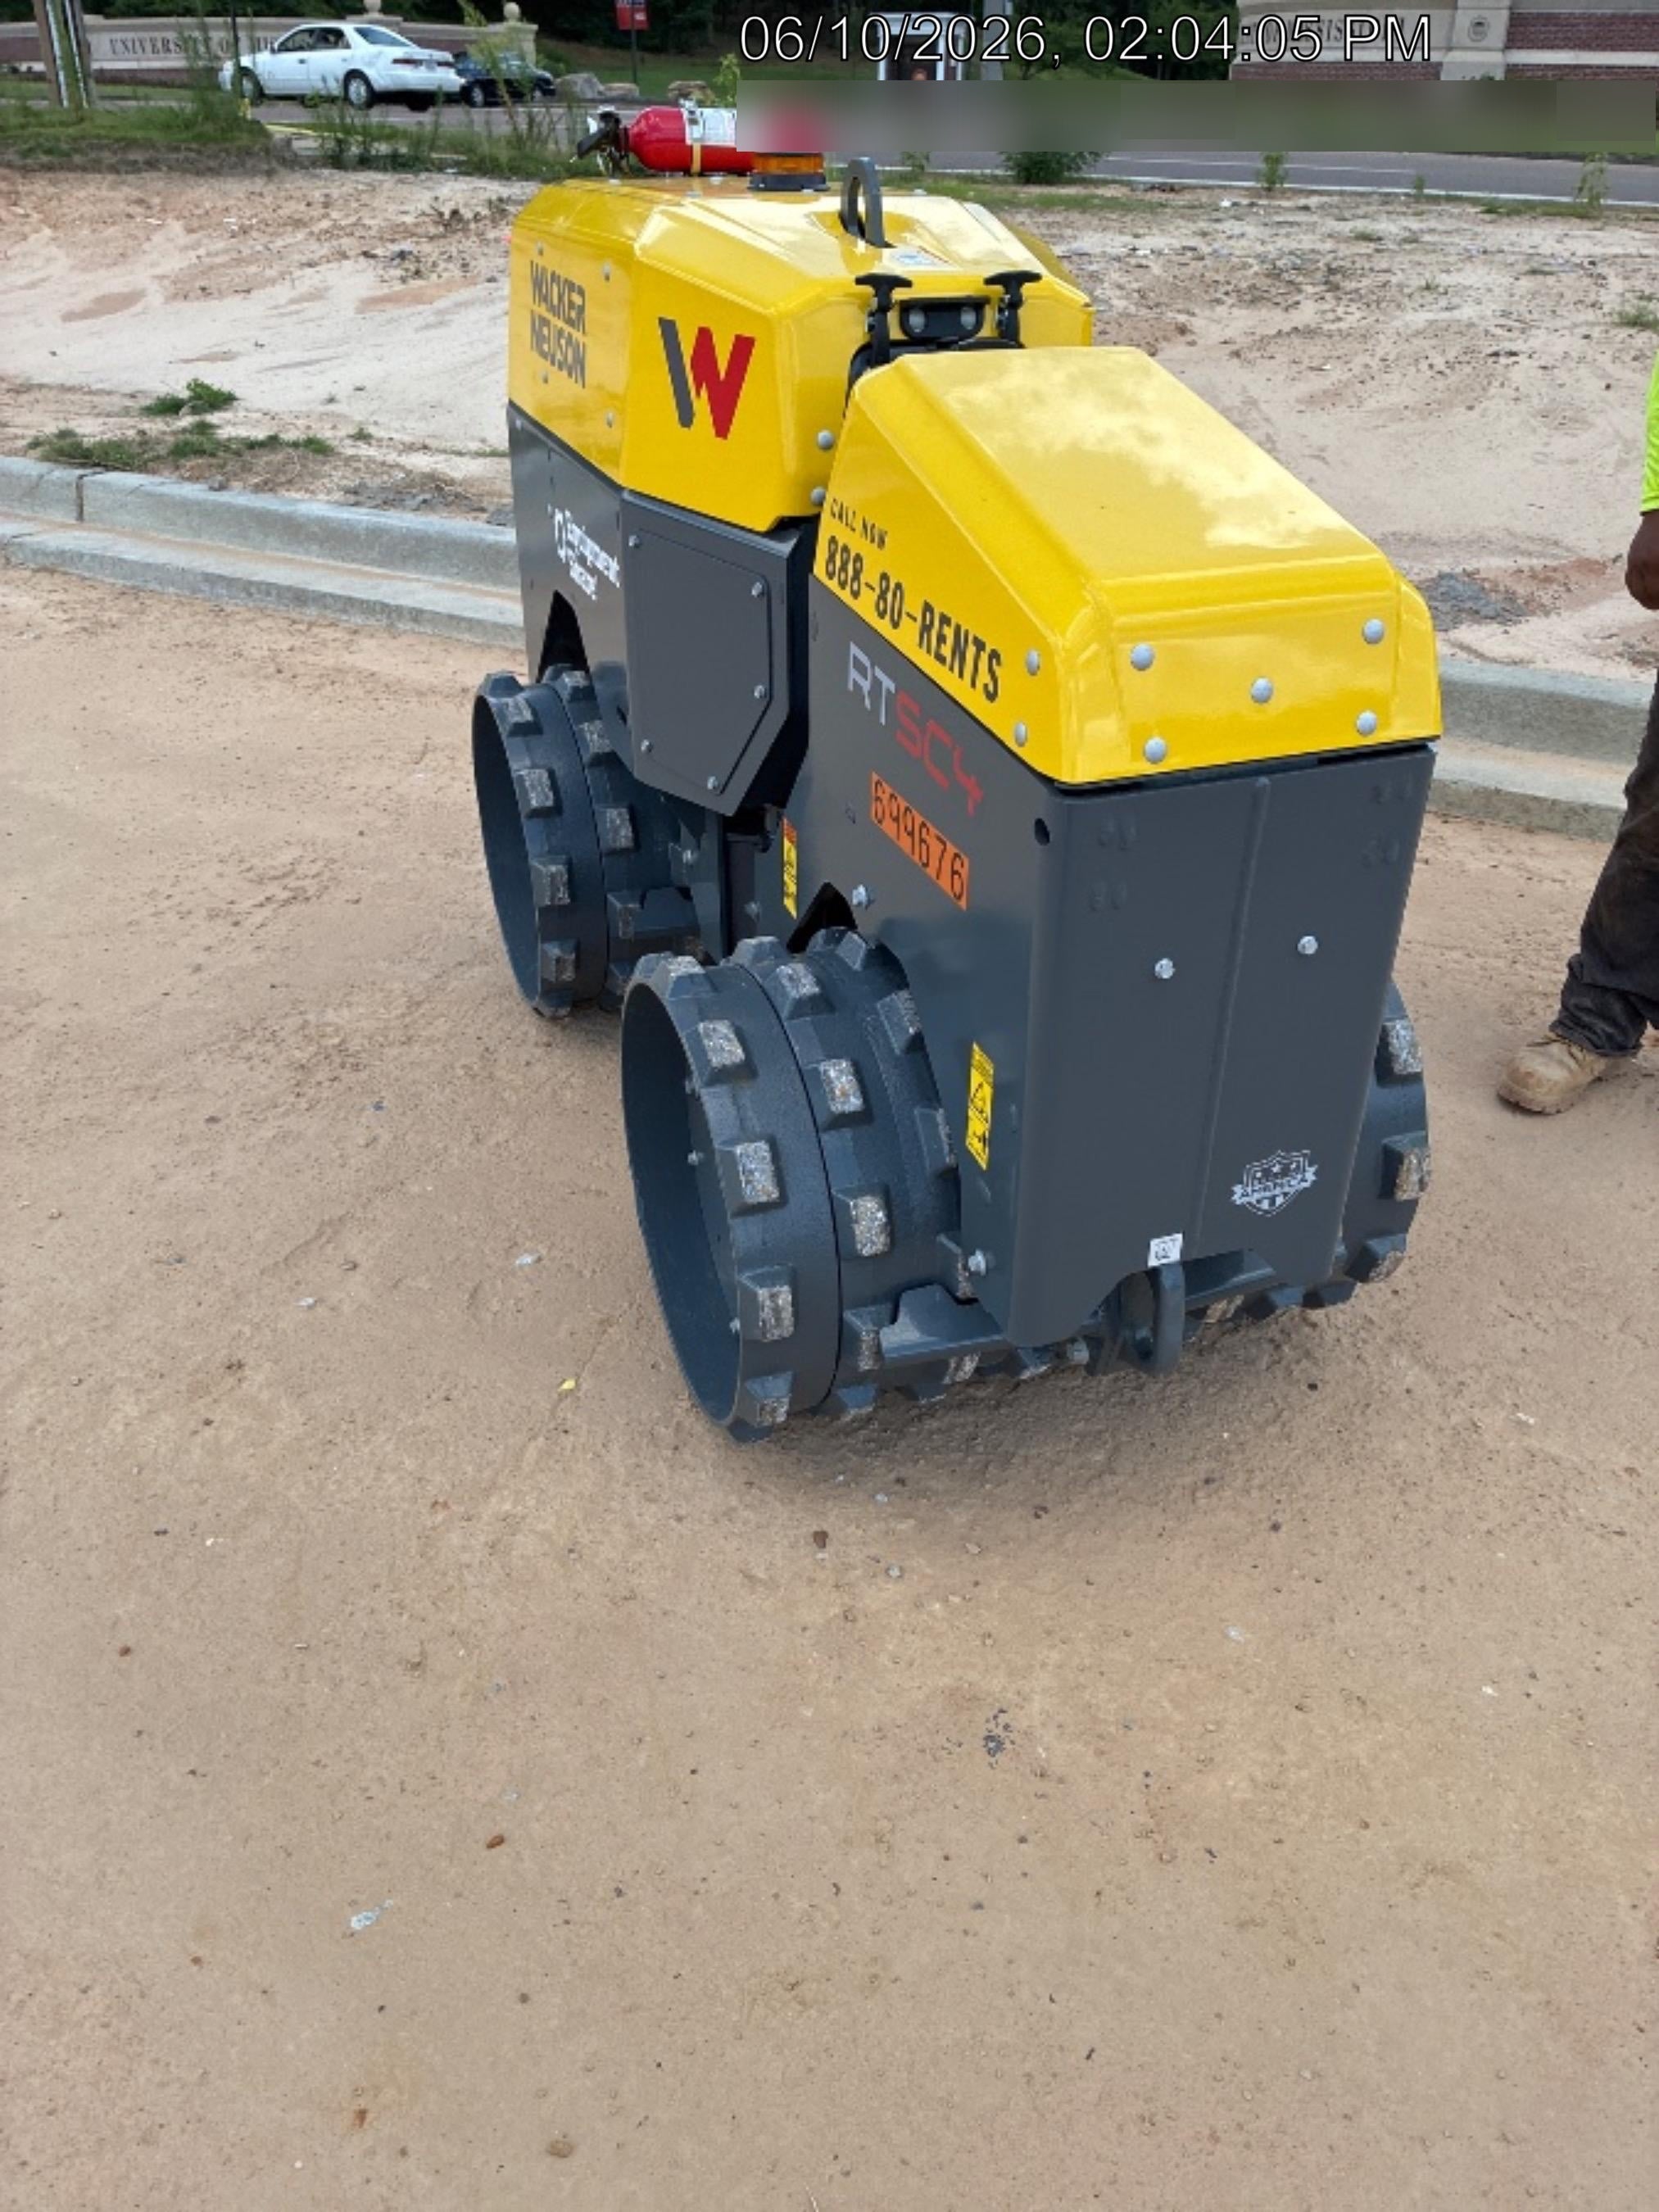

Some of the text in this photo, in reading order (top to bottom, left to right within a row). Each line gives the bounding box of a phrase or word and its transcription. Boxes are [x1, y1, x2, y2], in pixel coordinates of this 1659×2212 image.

[110, 37, 211, 56] UNIVERS
[530, 260, 585, 337] WACKER
[530, 309, 585, 389] NEUSON
[830, 497, 888, 551] CALL NOW
[825, 535, 1002, 703] 888-80-RENTS
[873, 779, 966, 901] 699676
